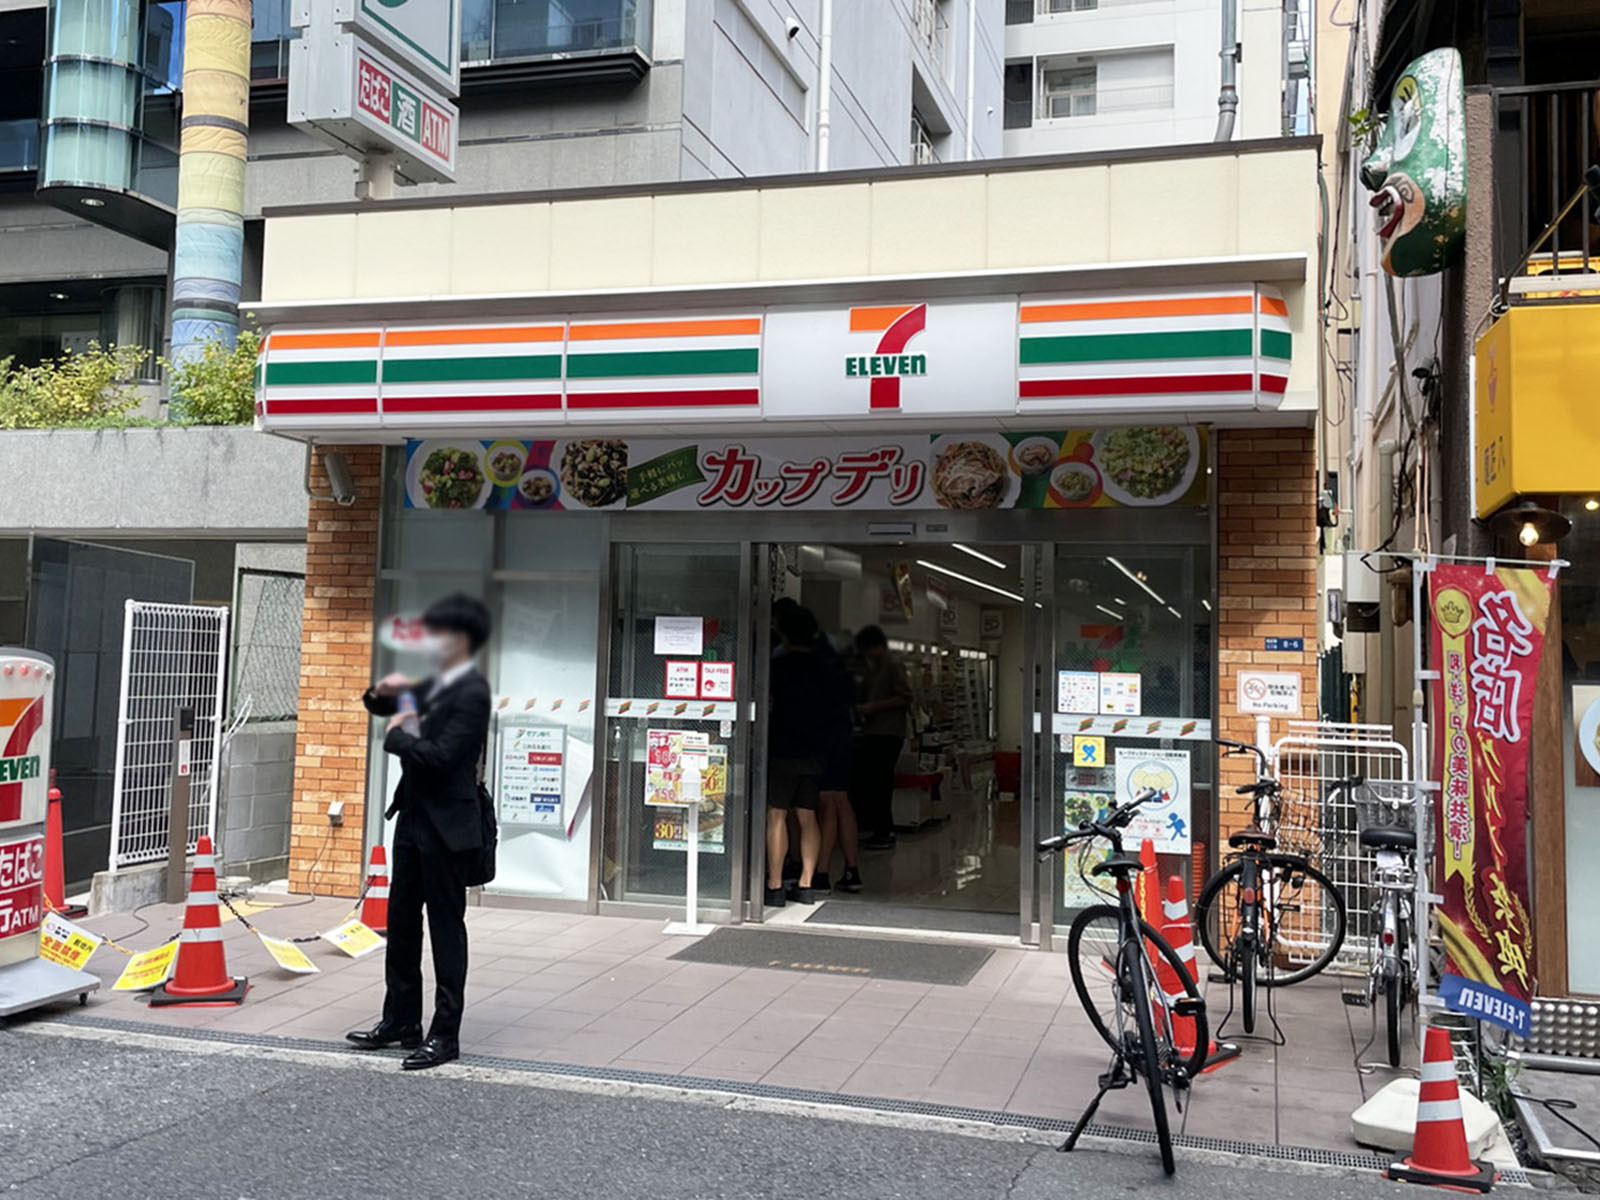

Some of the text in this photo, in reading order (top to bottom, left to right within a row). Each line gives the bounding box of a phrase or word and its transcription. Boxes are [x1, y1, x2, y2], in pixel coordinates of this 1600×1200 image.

[360, 65, 450, 161] たばこ 酒 ATM
[849, 303, 927, 409] 7
[698, 446, 924, 505] カップデリ
[1263, 702, 1289, 710] Parking
[0, 843, 42, 888] たばこ
